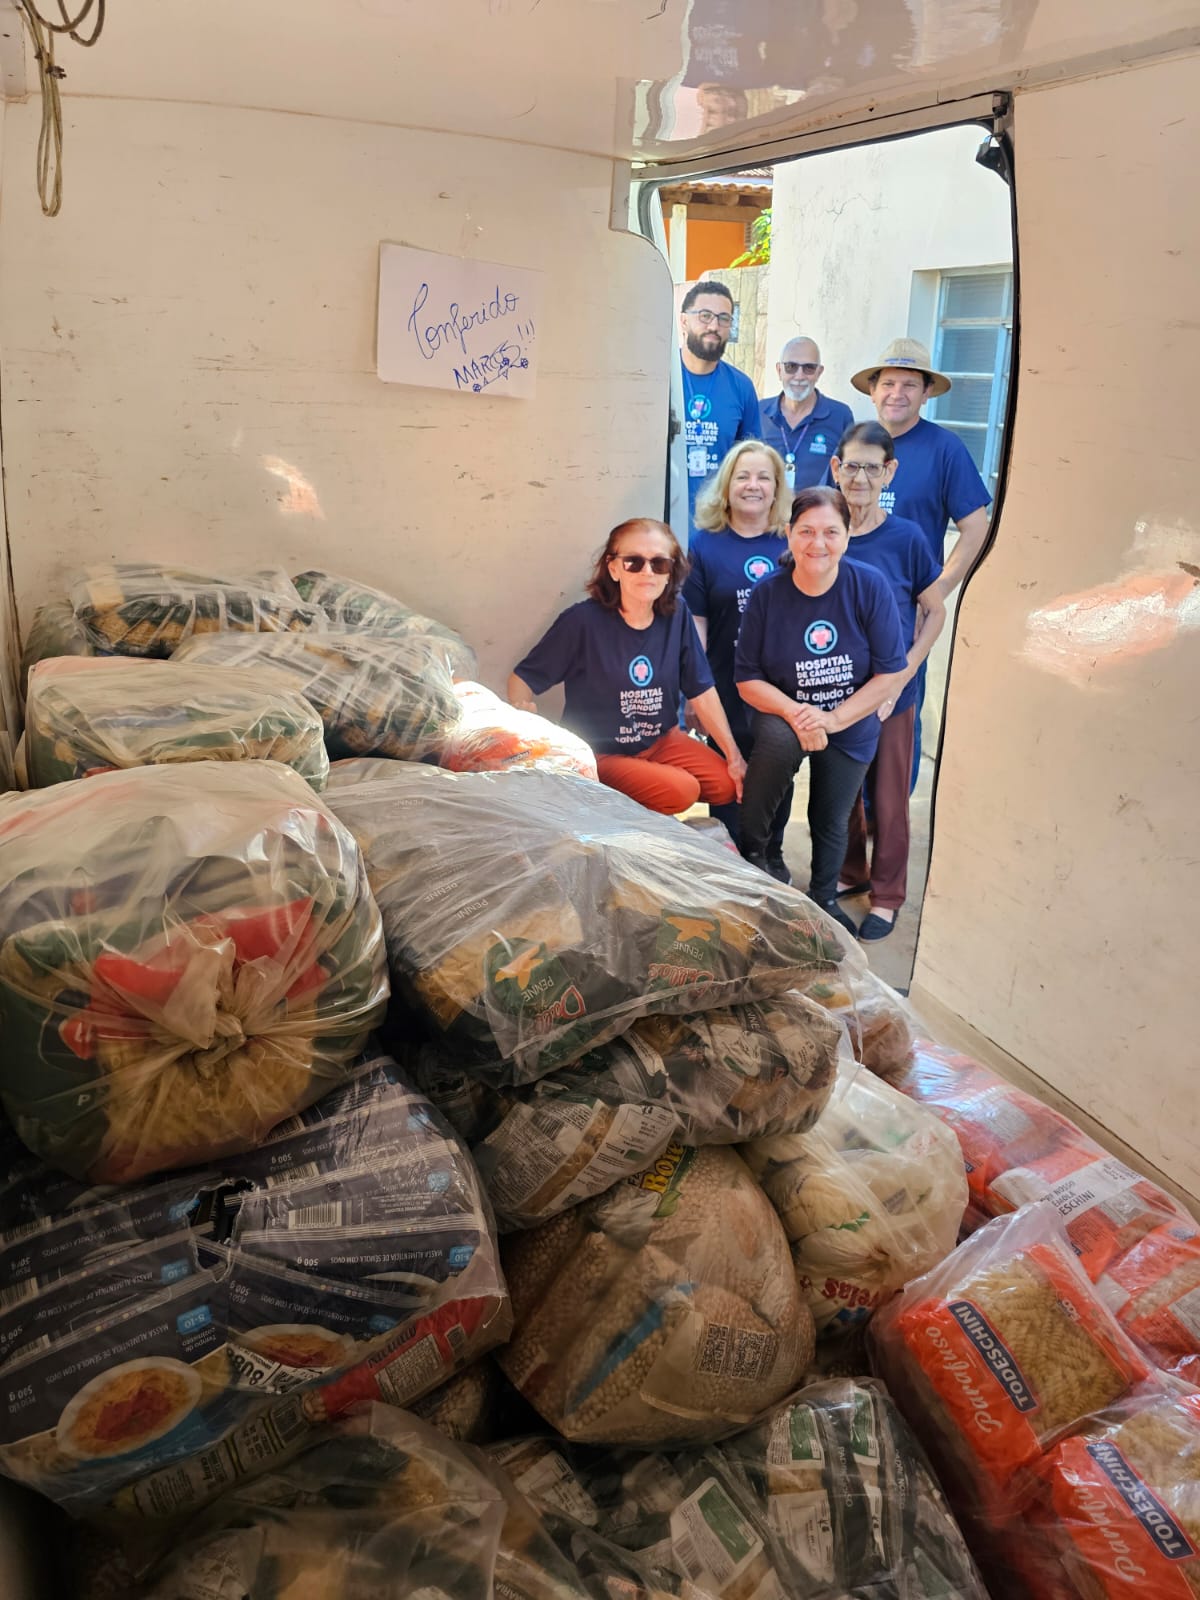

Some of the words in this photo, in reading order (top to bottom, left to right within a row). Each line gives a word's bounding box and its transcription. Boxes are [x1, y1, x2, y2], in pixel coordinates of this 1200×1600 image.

[408, 283, 519, 359] Conferido
[795, 654, 853, 671] HOSPITAL
[796, 671, 808, 679] DE
[841, 664, 853, 672] DE
[798, 671, 854, 687] CATANDUVA
[620, 687, 663, 700] HOSPITAL
[796, 690, 810, 701] Eu
[811, 688, 845, 703] ajudo
[619, 726, 633, 735] Eu
[671, 941, 704, 960] PENNE
[521, 976, 554, 1002] PENNE
[1058, 1190, 1096, 1216] ESCHINI
[303, 1257, 319, 1266] 500
[329, 1256, 345, 1264] OVOS
[346, 1255, 358, 1263] COM
[234, 1283, 250, 1297] 500
[147, 1322, 169, 1337] MASSA
[955, 1305, 1028, 1407] TODESCHINI
[926, 1326, 1003, 1433] Parafuso
[1094, 1444, 1182, 1555] TODESCHINI
[1068, 1478, 1146, 1582] Parafu
